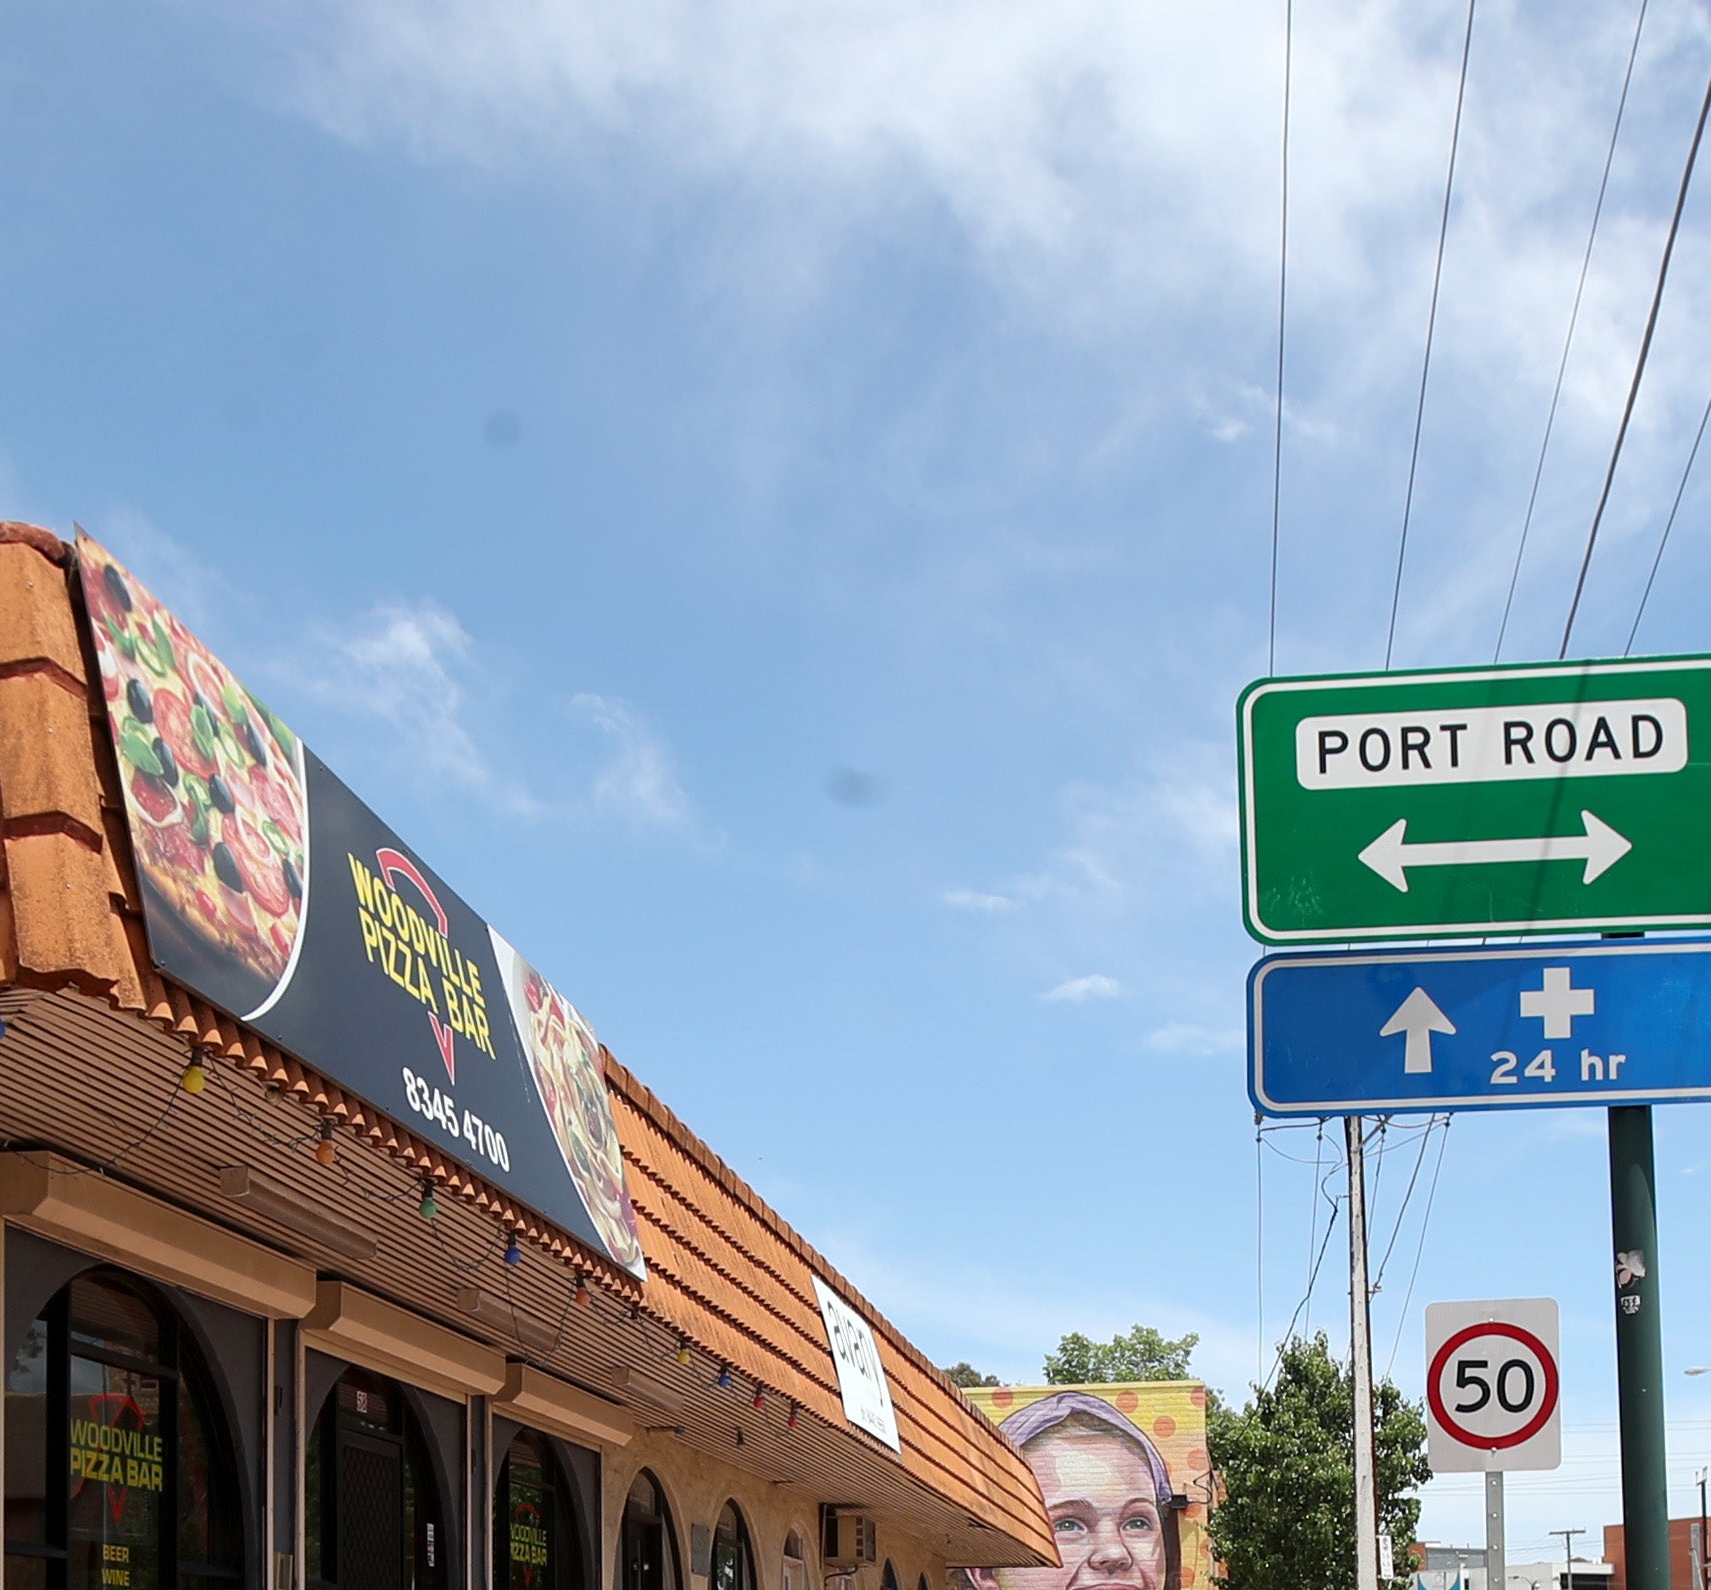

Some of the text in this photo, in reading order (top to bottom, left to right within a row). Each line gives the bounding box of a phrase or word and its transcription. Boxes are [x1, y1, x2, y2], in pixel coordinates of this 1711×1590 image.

[1318, 714, 1664, 774] PORT ROAD
[347, 852, 486, 1009] WOODVILLE
[358, 906, 496, 1060] PIZZA BAR
[1489, 1049, 1627, 1085] 24 hr
[402, 1067, 510, 1173] 8345 4700
[1452, 1357, 1537, 1415] 50
[70, 1418, 163, 1463] WOODVILLE
[70, 1446, 163, 1492] PIZZA BAR
[101, 1568, 130, 1587] WINE
[102, 1544, 130, 1563] BEER
